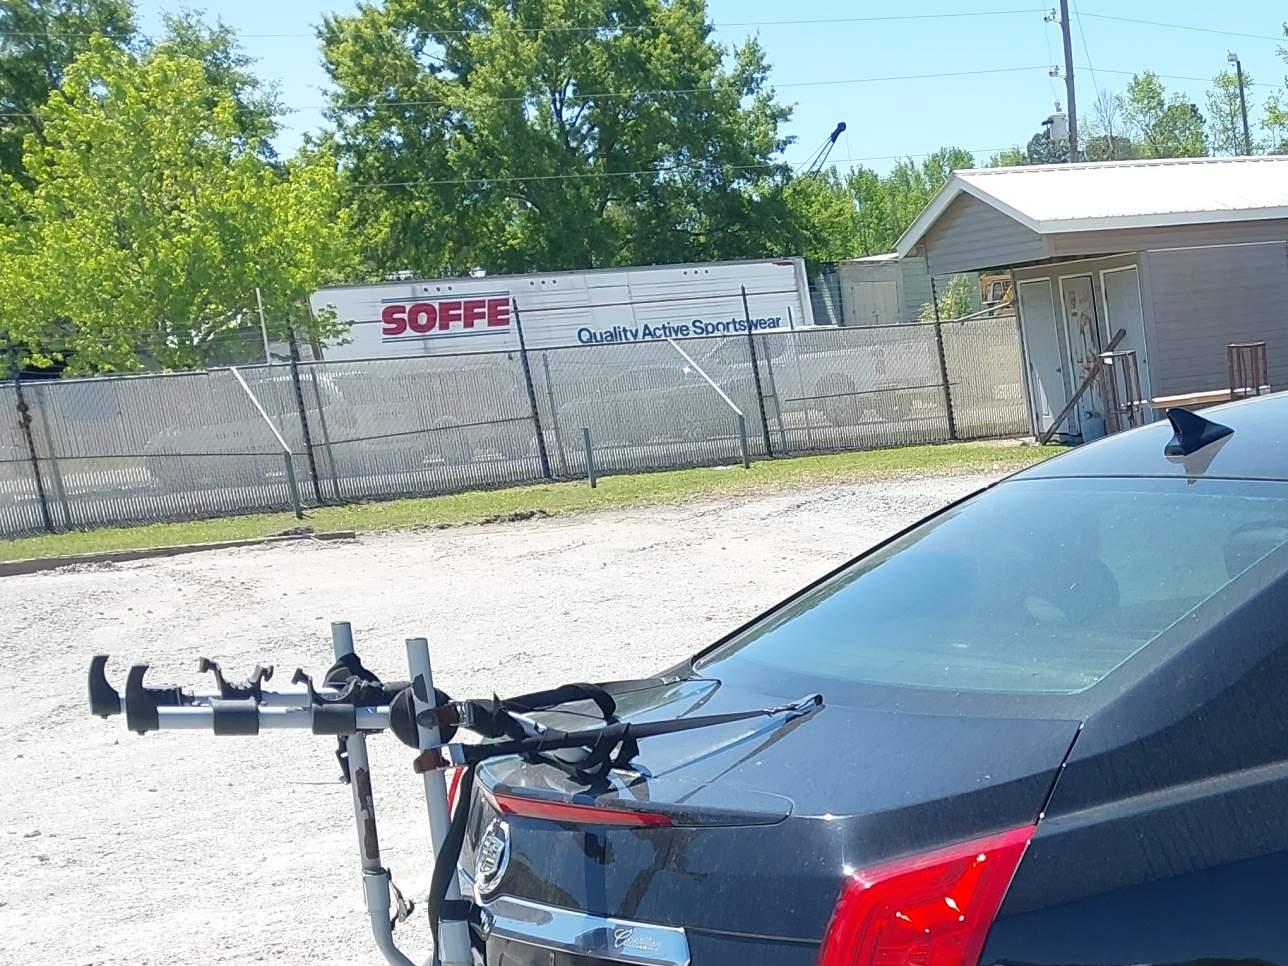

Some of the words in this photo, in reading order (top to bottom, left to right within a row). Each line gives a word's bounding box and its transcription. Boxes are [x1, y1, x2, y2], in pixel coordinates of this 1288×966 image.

[382, 298, 510, 336] SOFFE
[577, 326, 639, 343] Quality
[642, 322, 690, 340] Active
[691, 316, 781, 336] Sportswear
